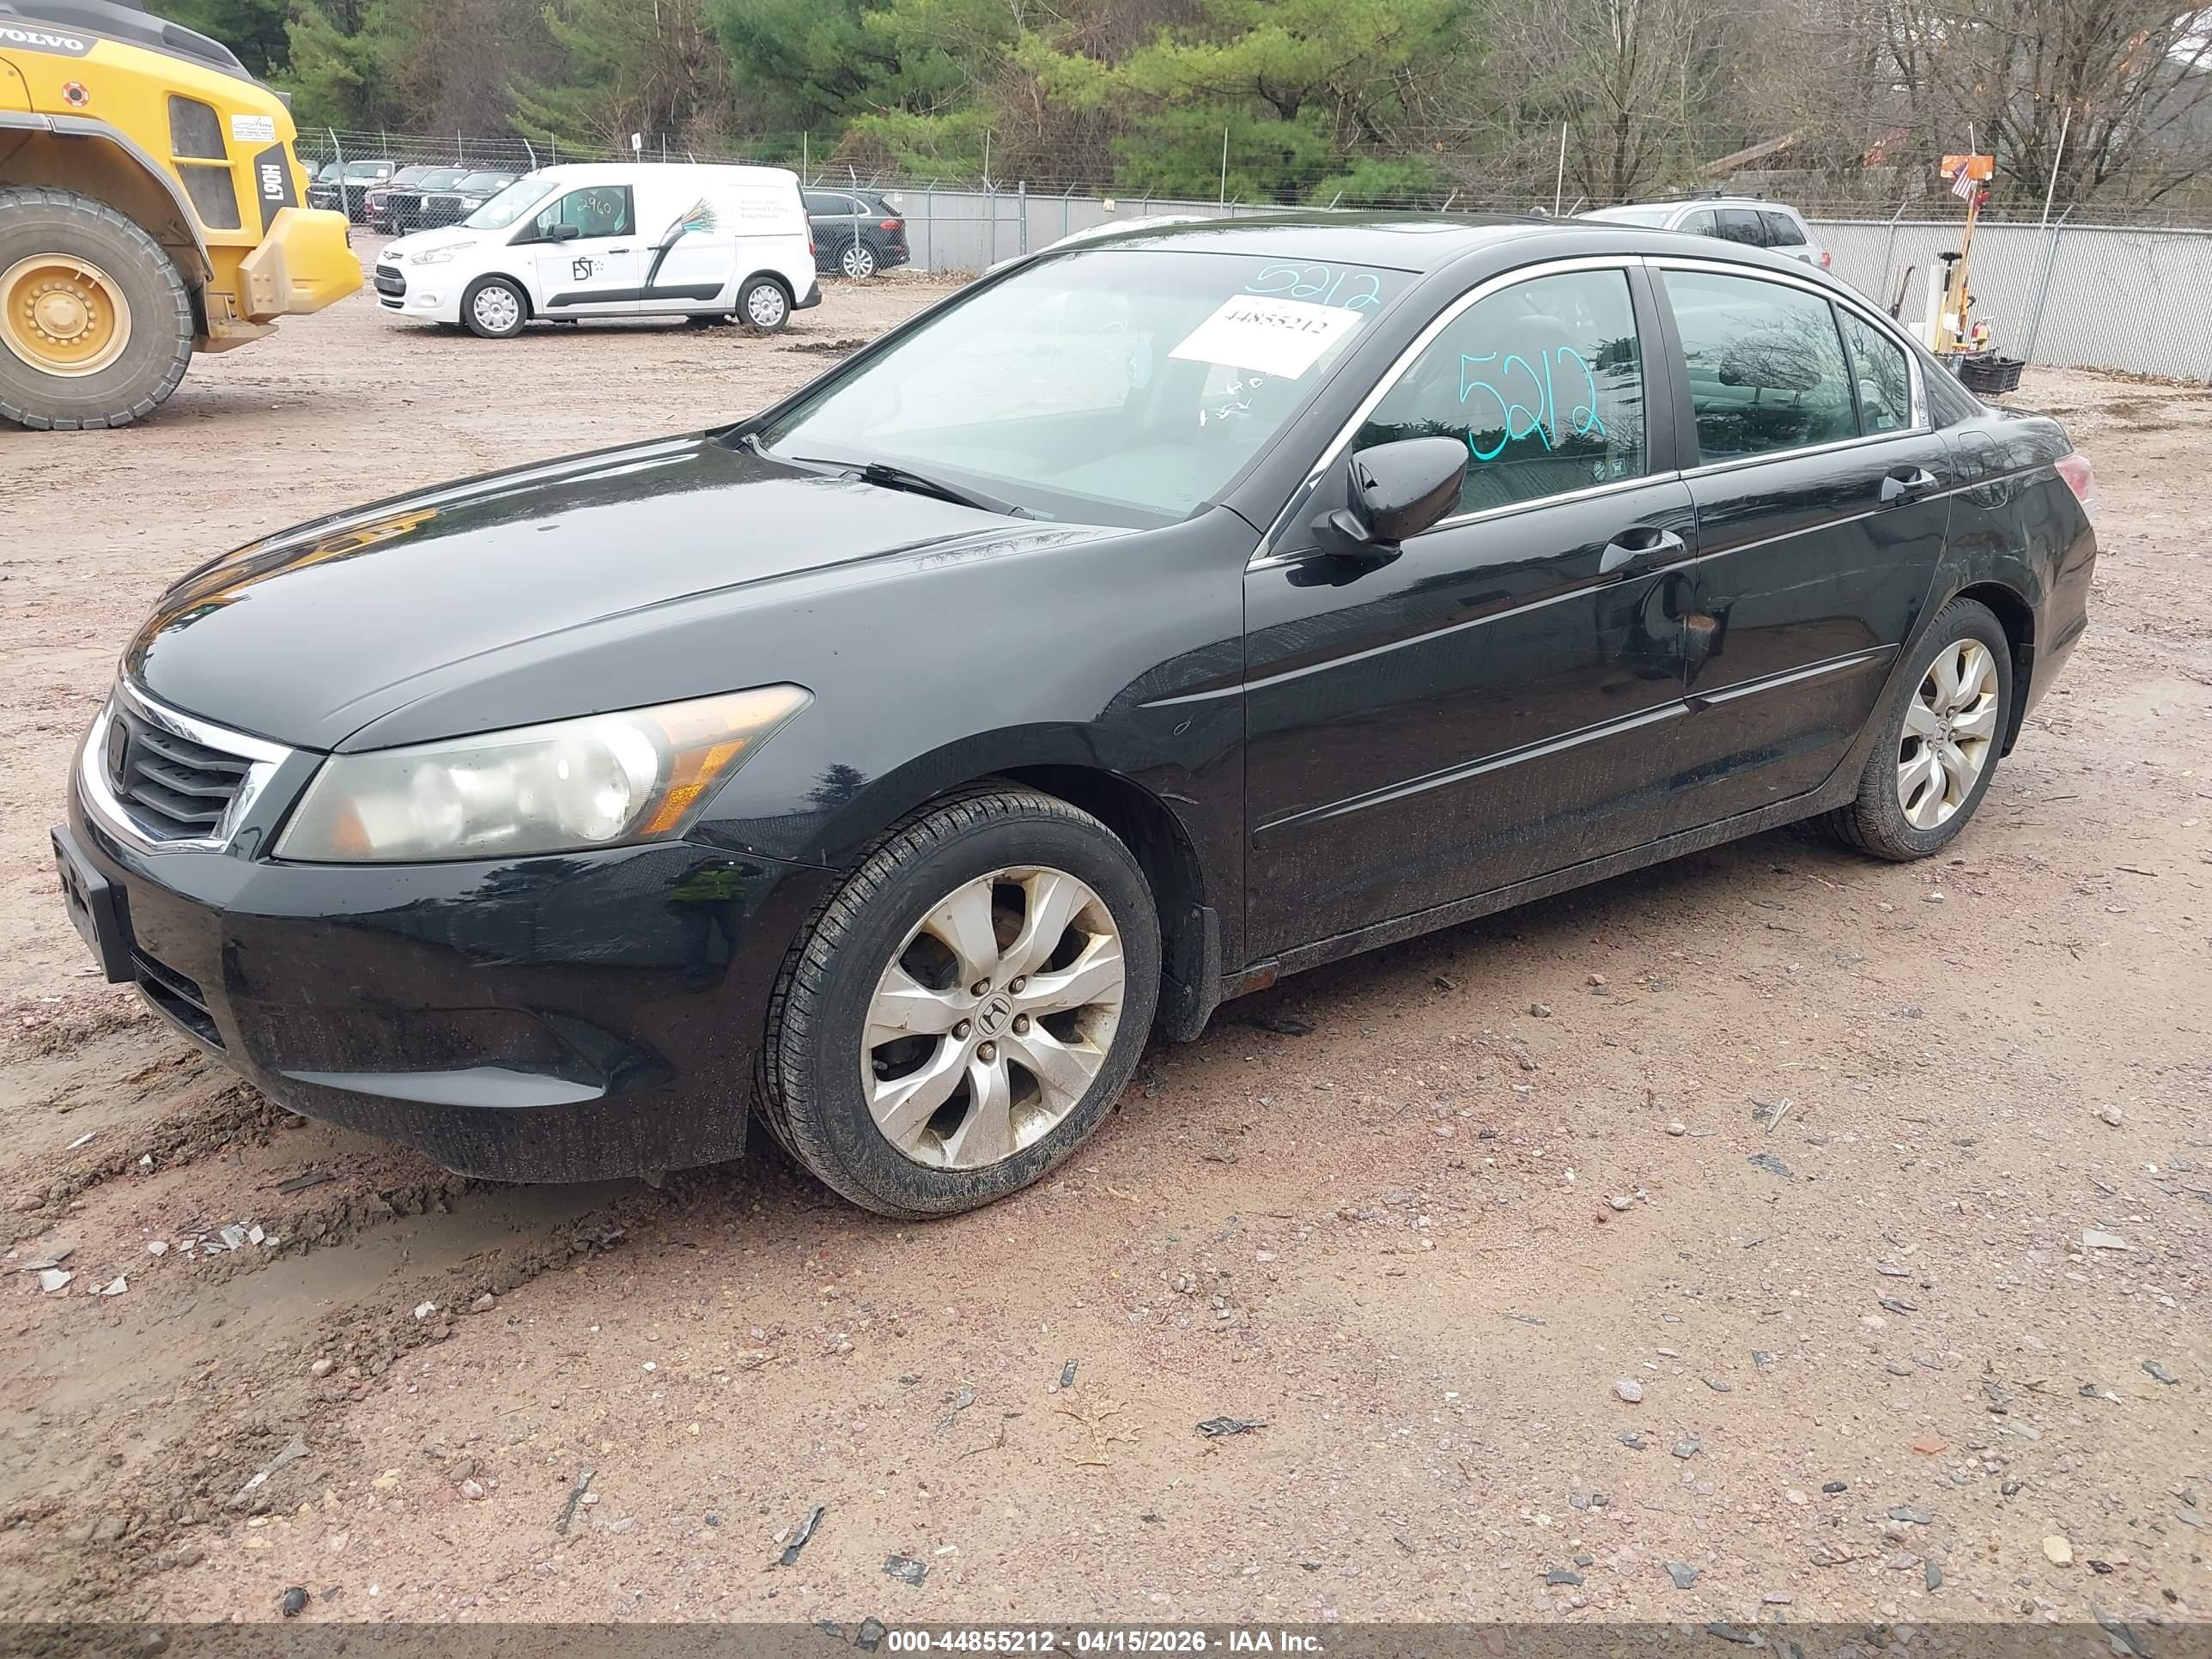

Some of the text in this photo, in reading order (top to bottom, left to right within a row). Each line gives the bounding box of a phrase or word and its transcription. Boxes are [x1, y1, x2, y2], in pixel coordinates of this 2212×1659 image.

[260, 164, 284, 200] L90H
[577, 198, 611, 214] 2960
[1245, 264, 1381, 310] 5212
[1225, 310, 1328, 334] 44855212
[1460, 347, 1607, 460] 5212
